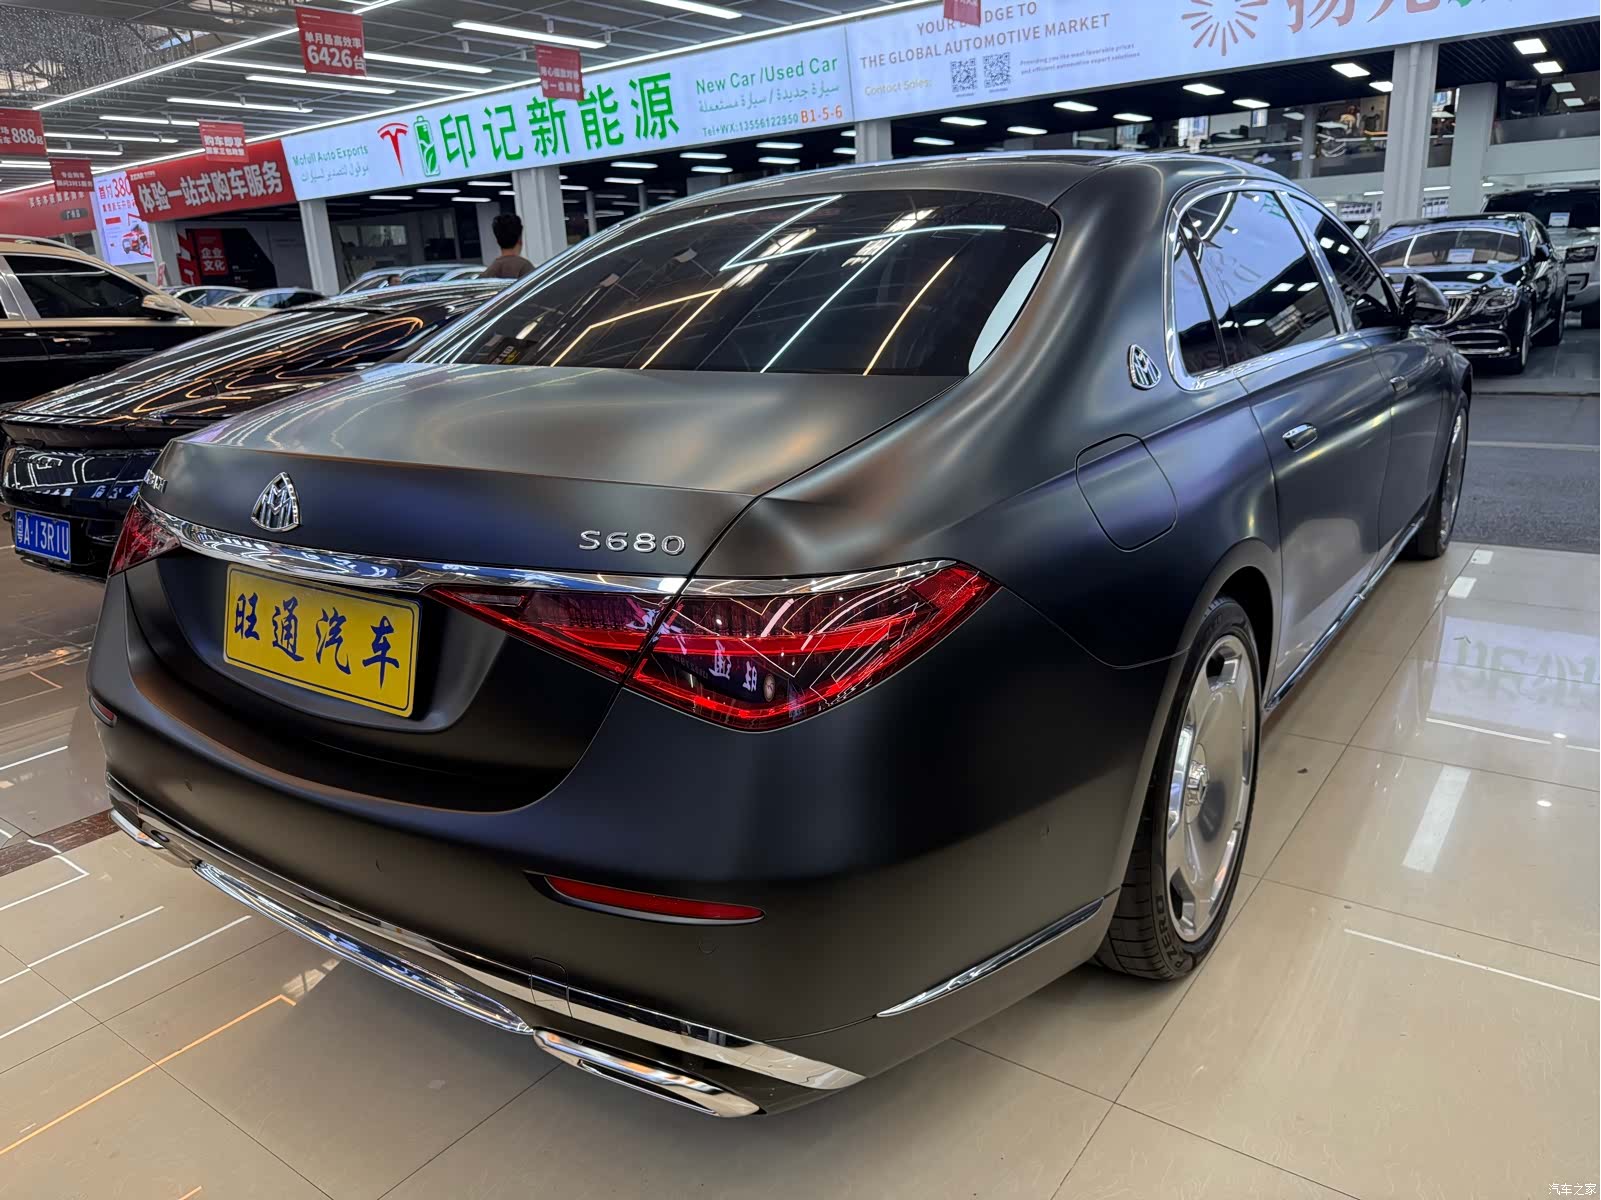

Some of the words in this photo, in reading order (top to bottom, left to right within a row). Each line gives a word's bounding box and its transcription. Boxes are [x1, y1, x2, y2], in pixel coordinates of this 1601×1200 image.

[916, 19, 955, 36] YOUR
[1018, 2, 1037, 17] TO
[305, 32, 361, 48] 单月最高效率
[307, 45, 366, 70] 6426台
[860, 54, 886, 69] THE
[889, 48, 941, 66] GLOBAL
[944, 26, 1040, 55] AUTOMOTIVE
[1045, 13, 1111, 36] MARKET
[696, 79, 726, 95] New
[730, 72, 756, 88] Car
[760, 60, 804, 83] /Used
[809, 57, 838, 74] Car
[440, 72, 679, 168] 印记新能源
[138, 161, 283, 213] 体验一站式购车服务
[204, 260, 226, 272] 文化
[579, 530, 686, 556] S680
[235, 590, 400, 689] 旺通汽车
